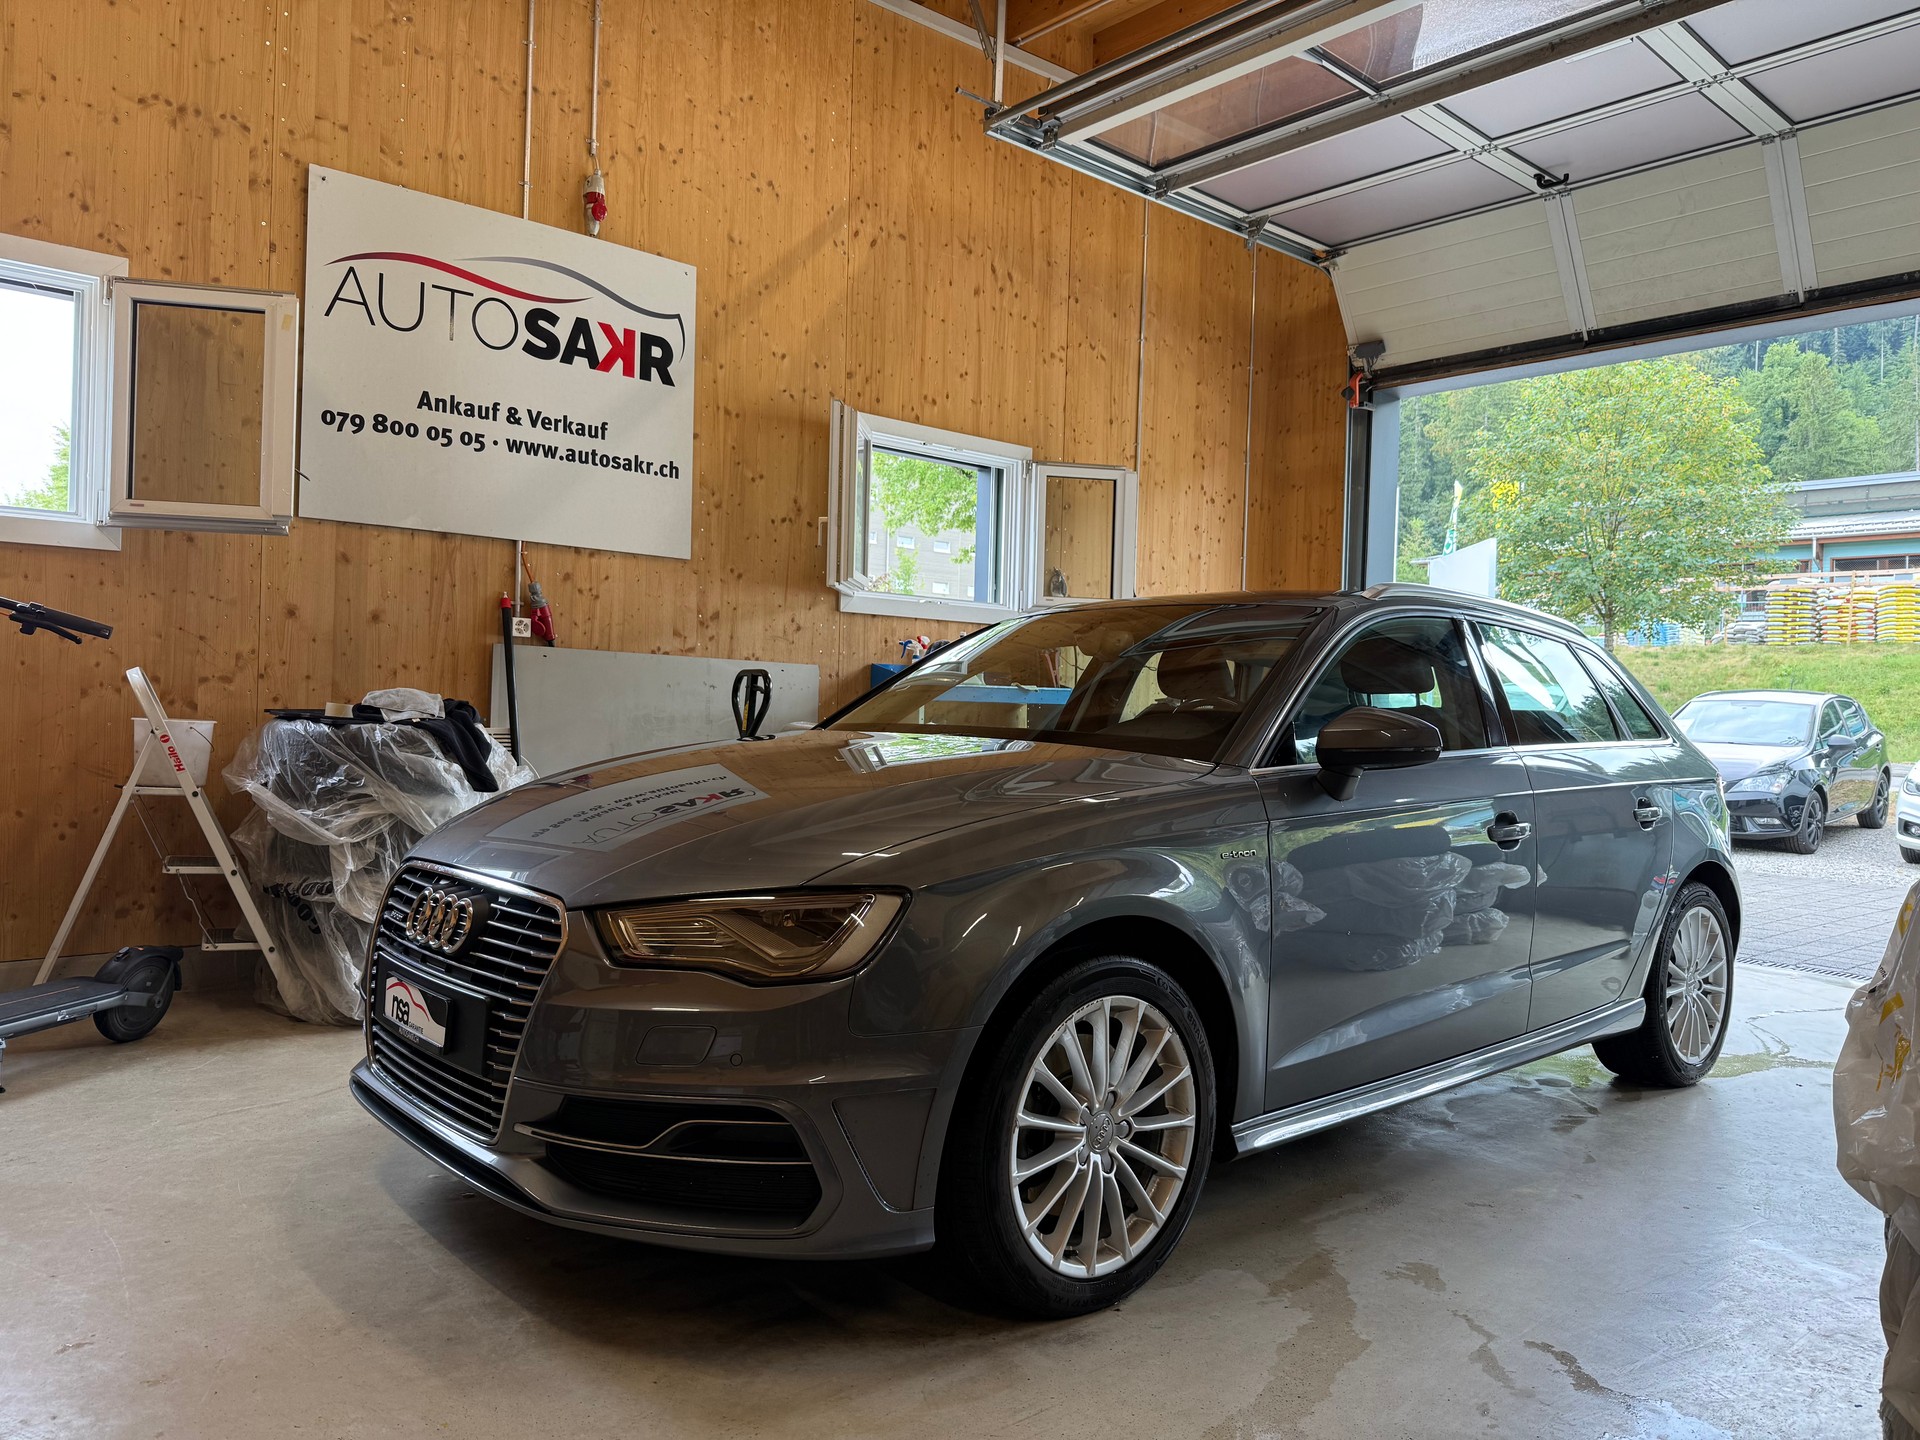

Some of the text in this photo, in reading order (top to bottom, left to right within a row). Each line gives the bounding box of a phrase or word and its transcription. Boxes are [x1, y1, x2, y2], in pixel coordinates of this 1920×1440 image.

[416, 391, 608, 440] Ankauf & Verkauf
[321, 410, 365, 435] 079
[372, 413, 419, 438] 800
[426, 426, 453, 447] 05
[459, 431, 486, 452] 05
[505, 438, 680, 479] www.autosakr.ch
[167, 745, 186, 772] Hailo
[1220, 849, 1257, 860] e-tron
[392, 995, 410, 1026] nsa
